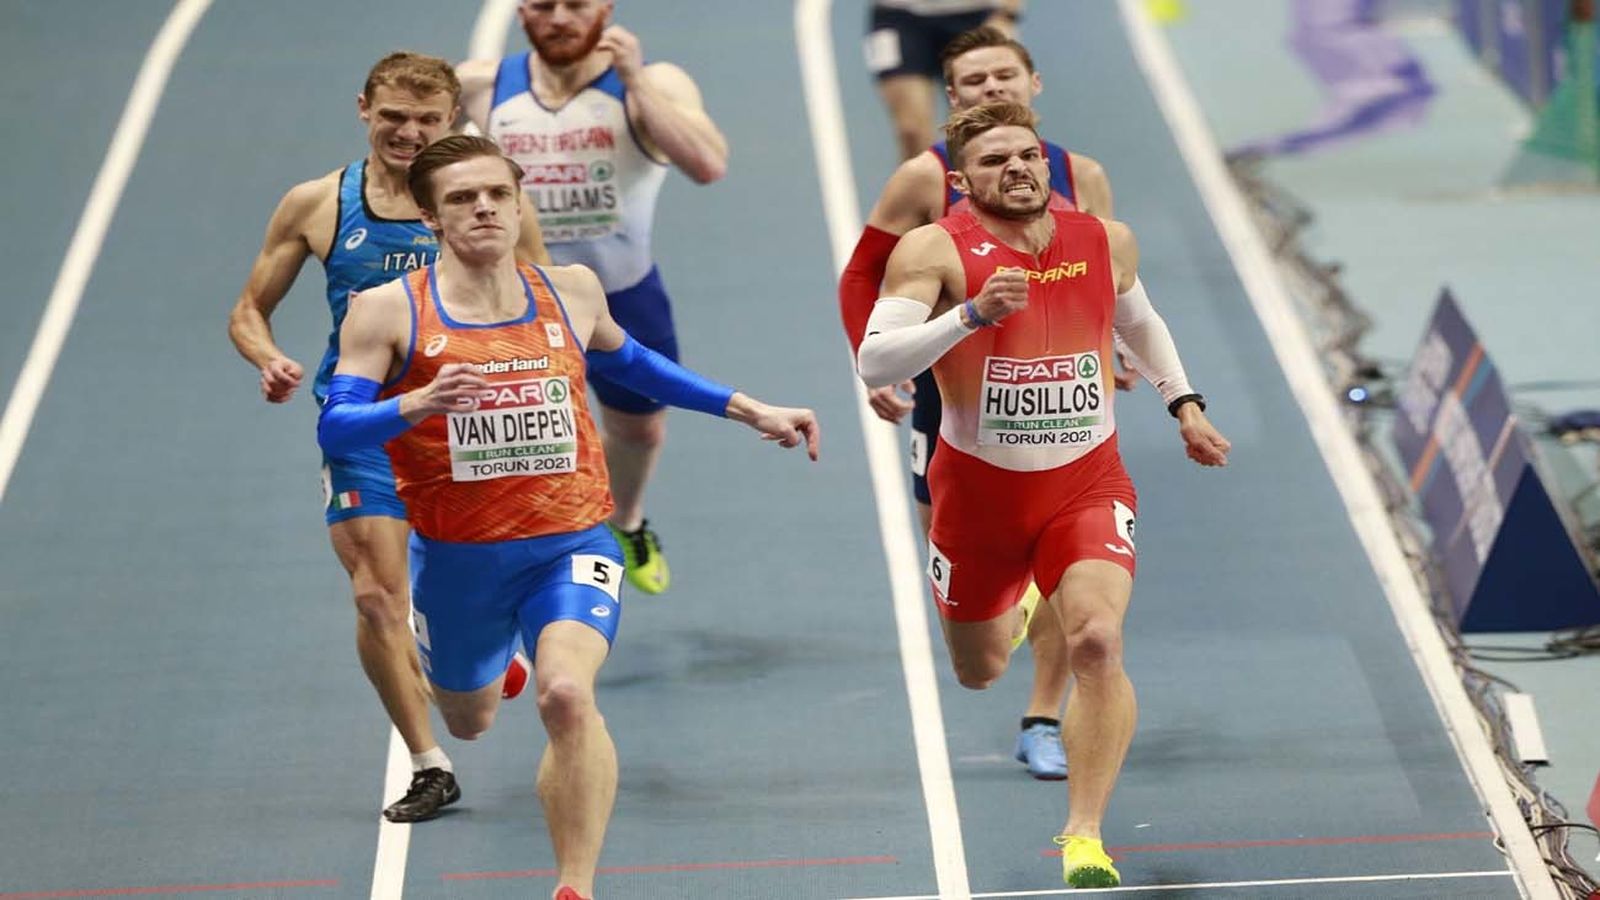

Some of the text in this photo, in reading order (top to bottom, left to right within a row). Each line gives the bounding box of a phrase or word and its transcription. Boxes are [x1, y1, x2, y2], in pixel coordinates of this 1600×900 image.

[384, 251, 441, 271] ITALI
[990, 359, 1074, 381] SPAR
[986, 382, 1100, 417] HUSILLOS
[453, 408, 573, 445] VAN DIEPEN
[1014, 420, 1039, 430] RUN
[1042, 418, 1079, 429] CLEAN
[1060, 430, 1092, 444] 2021
[486, 450, 511, 458] RUN
[515, 447, 556, 457] CLEAN
[534, 457, 571, 470] 2021
[593, 561, 610, 584] 5
[932, 556, 942, 581] 6
